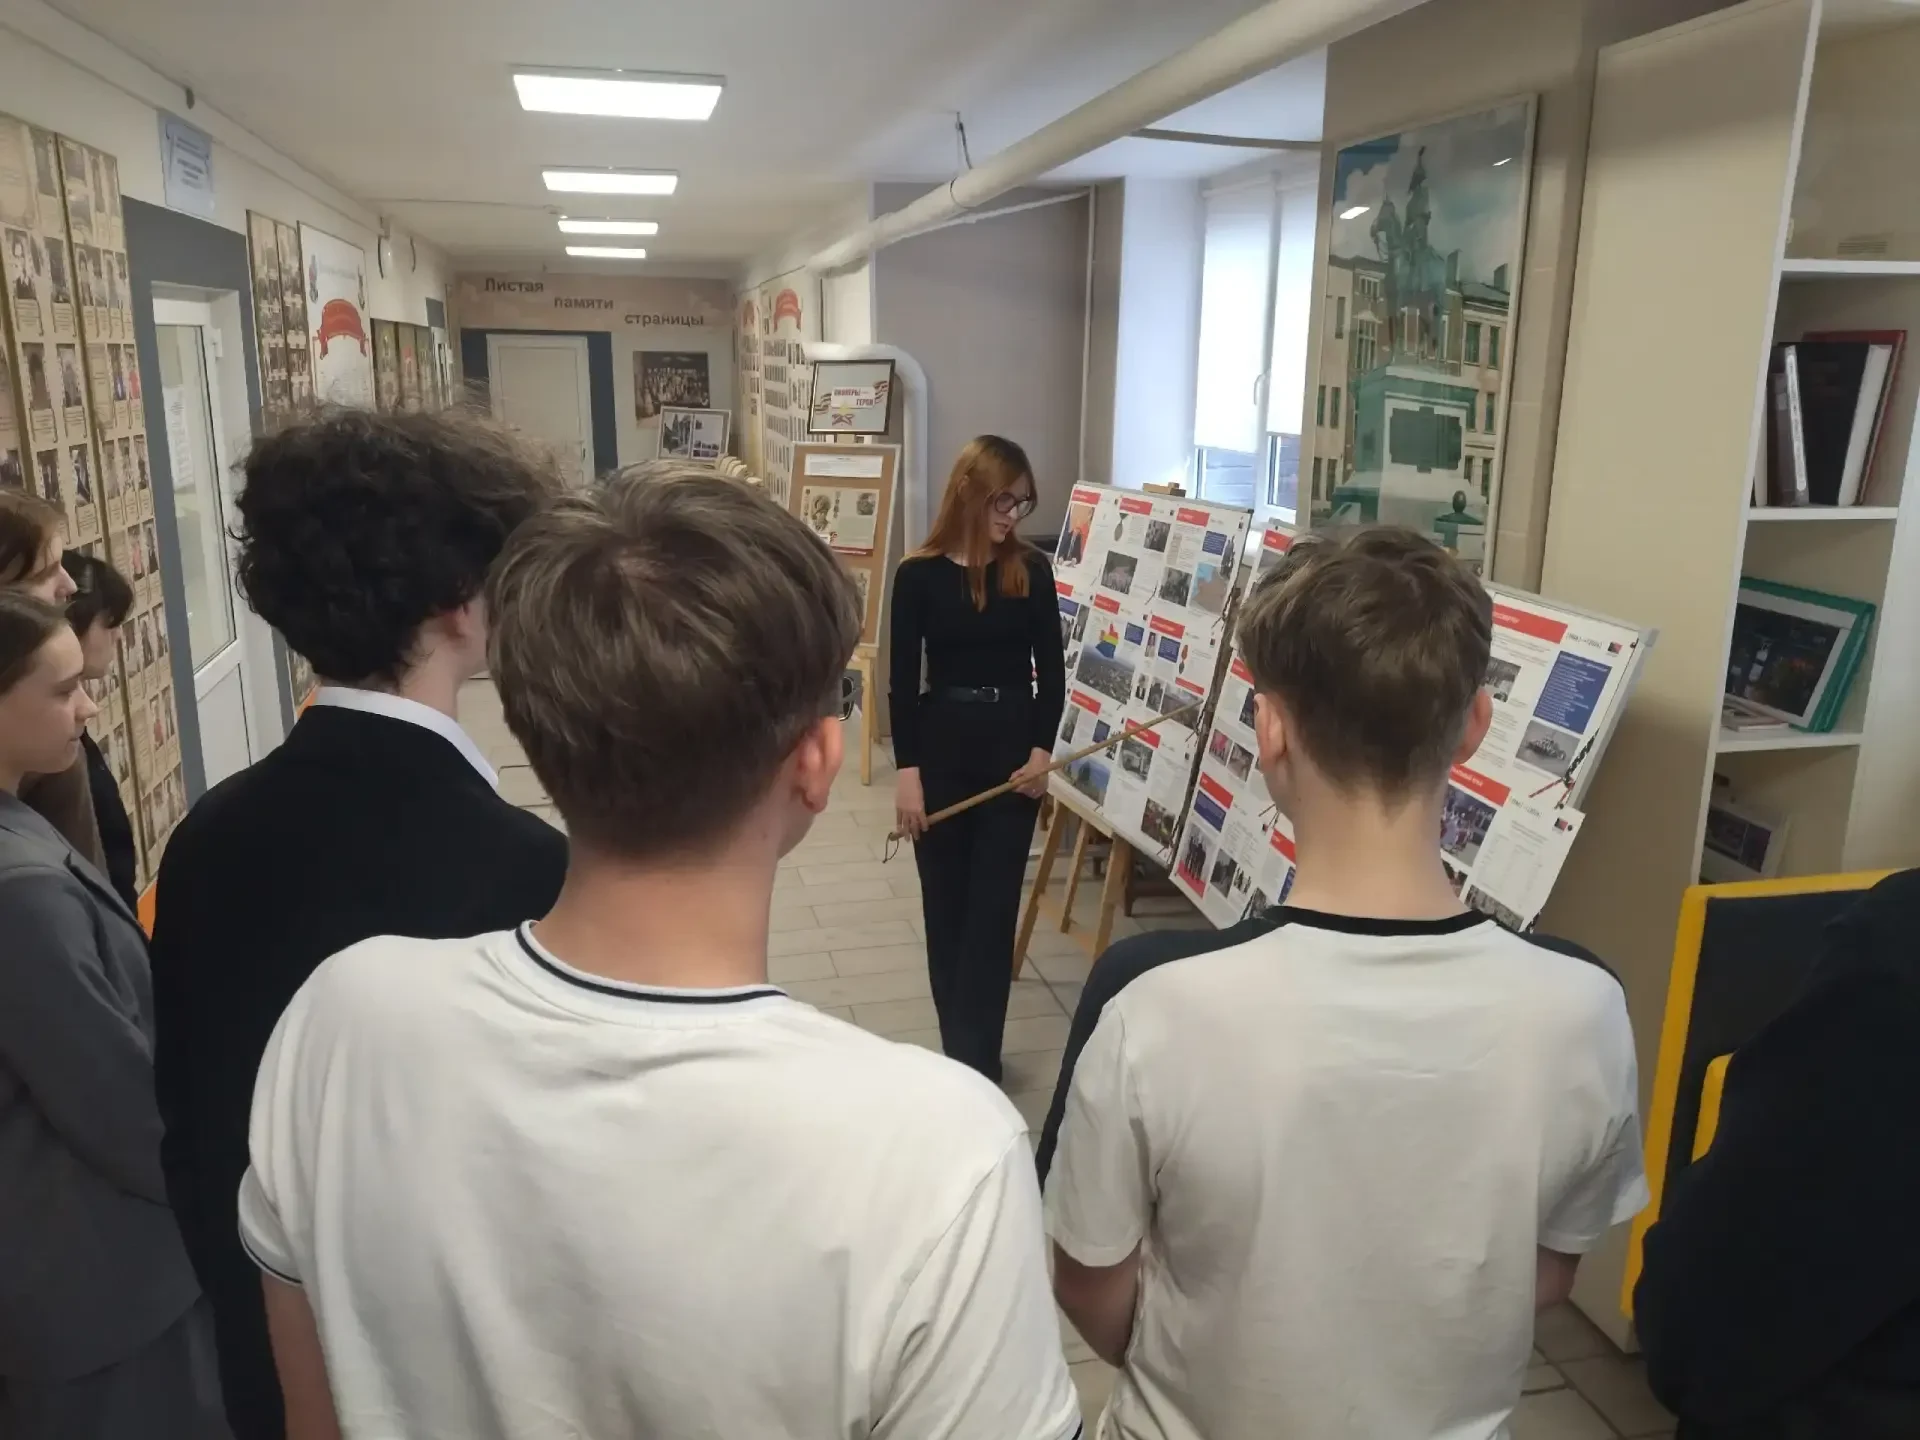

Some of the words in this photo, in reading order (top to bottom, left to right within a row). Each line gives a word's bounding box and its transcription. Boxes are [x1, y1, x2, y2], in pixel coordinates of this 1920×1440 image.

[485, 277, 544, 293] Листая
[554, 297, 614, 309] памяти
[624, 313, 704, 327] страницы
